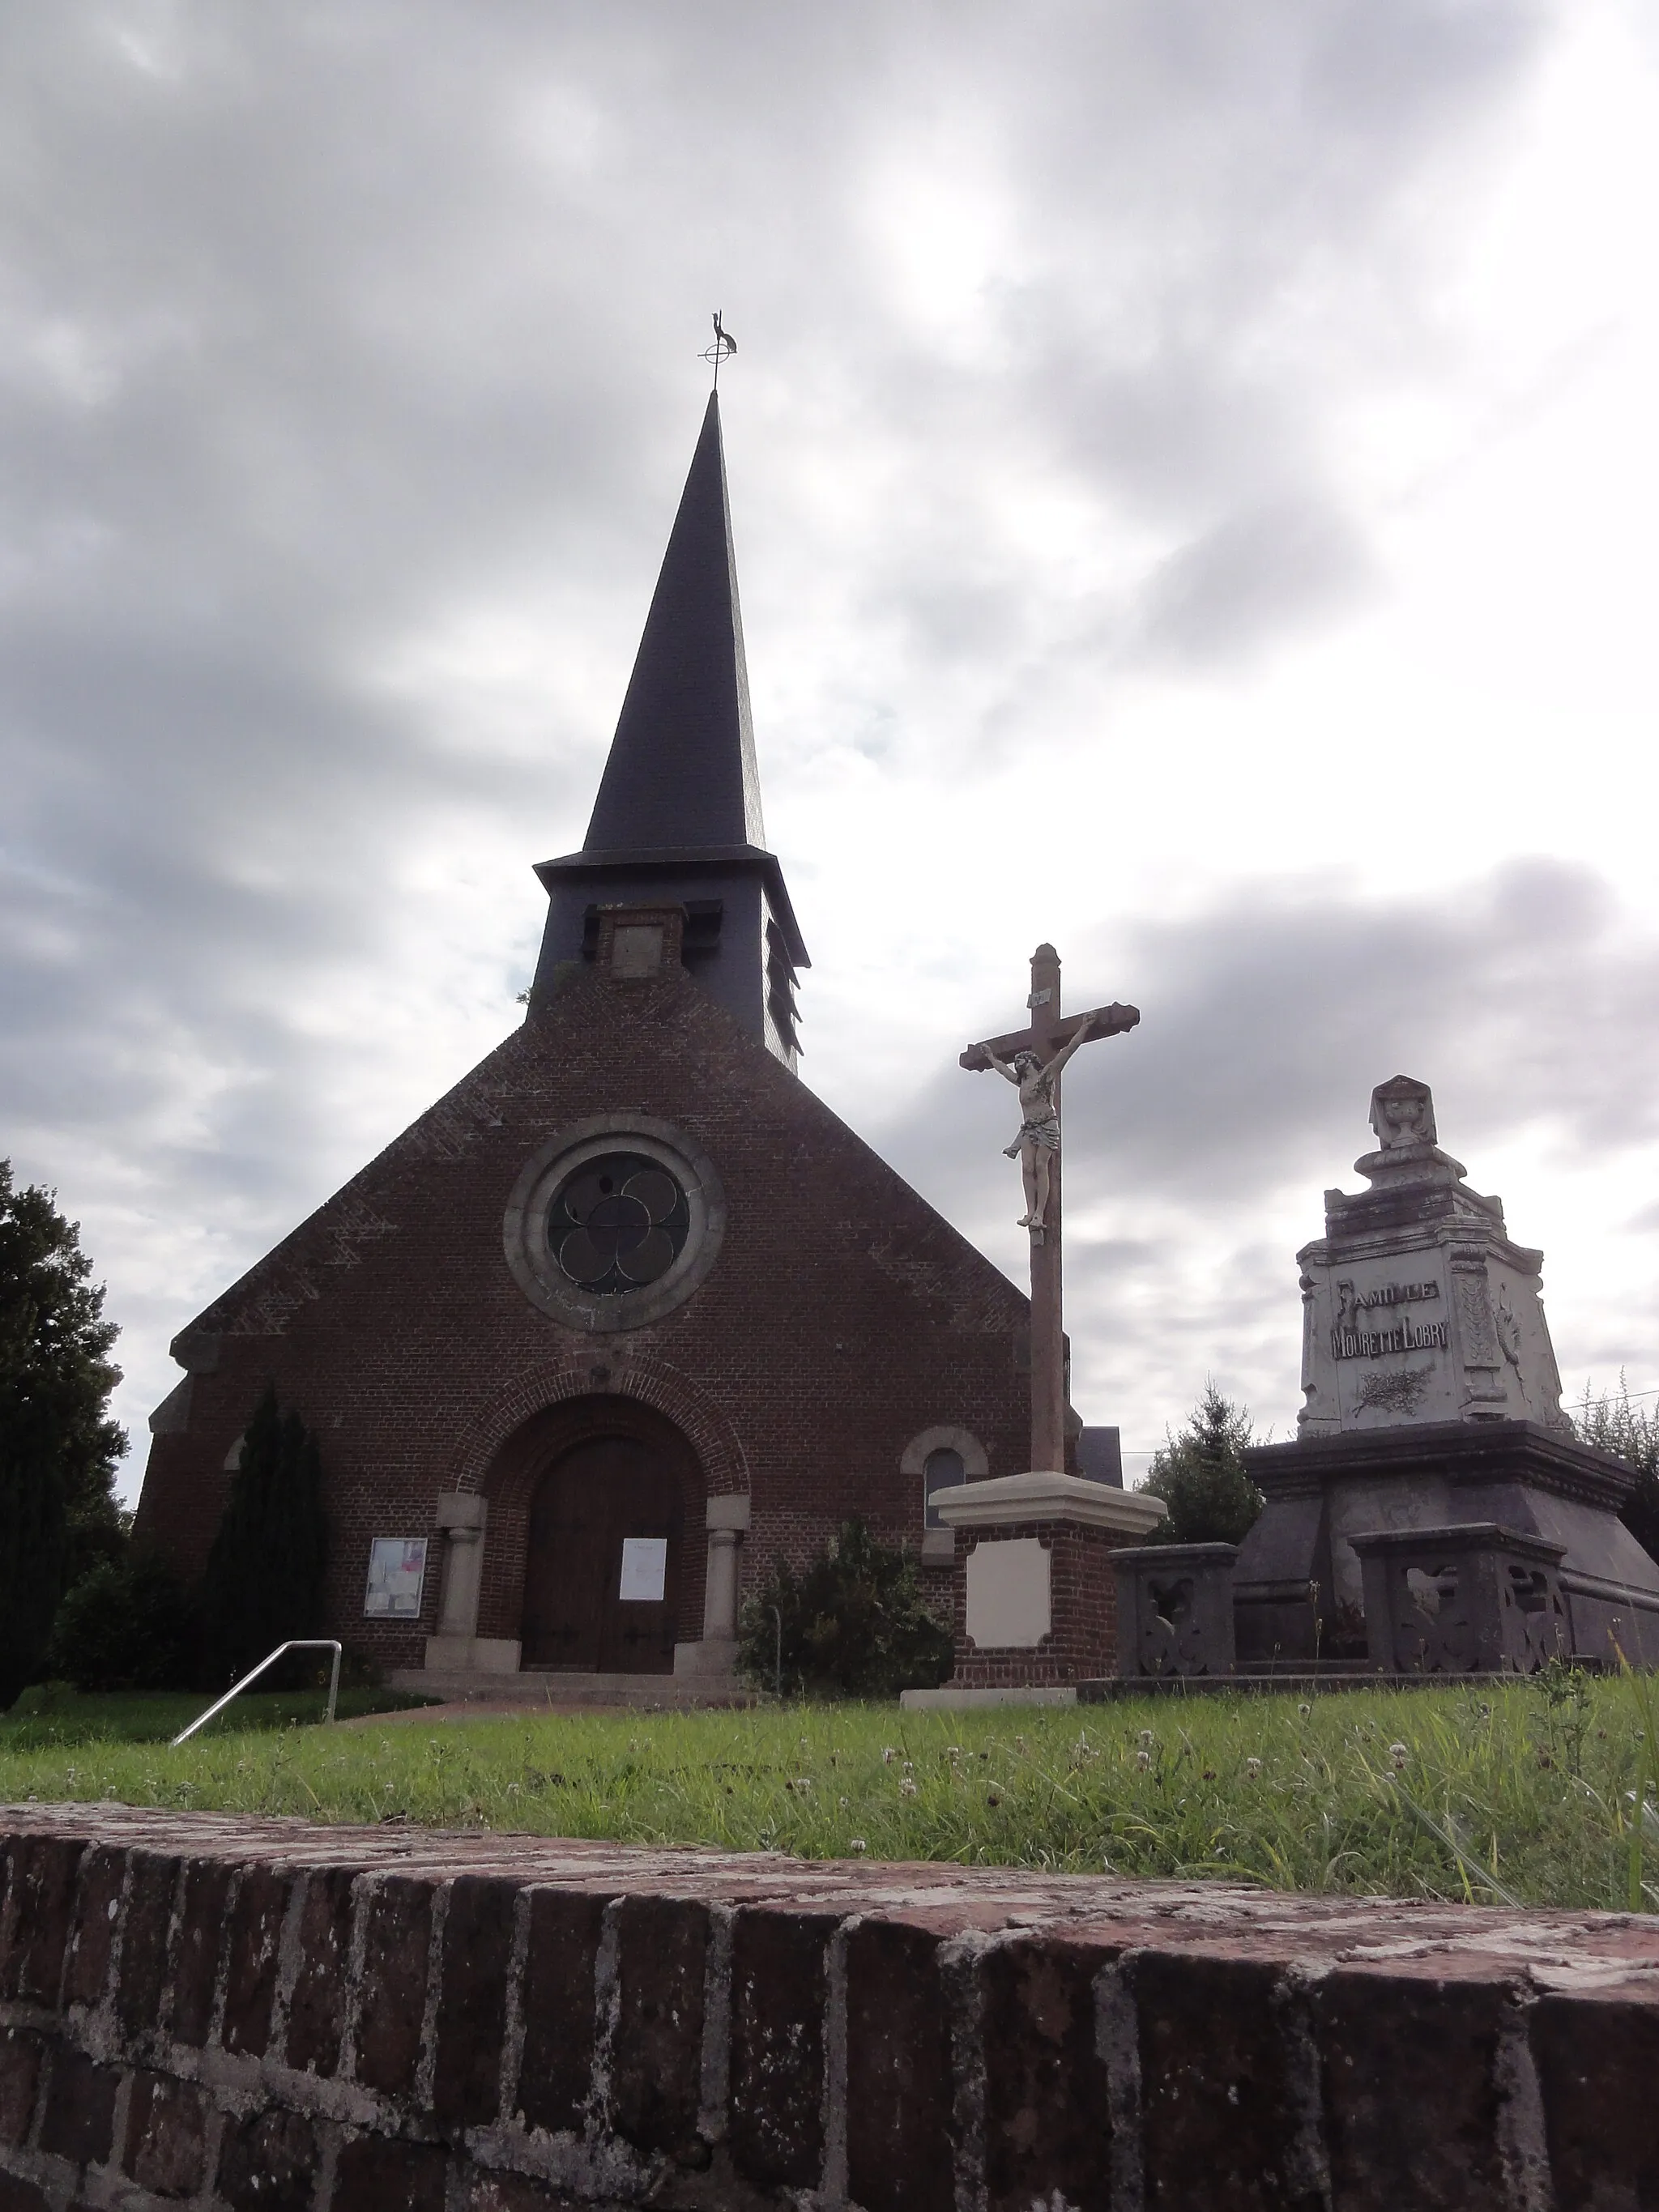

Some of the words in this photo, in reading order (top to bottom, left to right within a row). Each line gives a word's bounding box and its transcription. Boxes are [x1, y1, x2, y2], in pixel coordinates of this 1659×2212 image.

[1337, 1281, 1438, 1316] FAMILLE
[1333, 1327, 1401, 1360] MOURETTE
[1403, 1318, 1447, 1350] LOBRY
